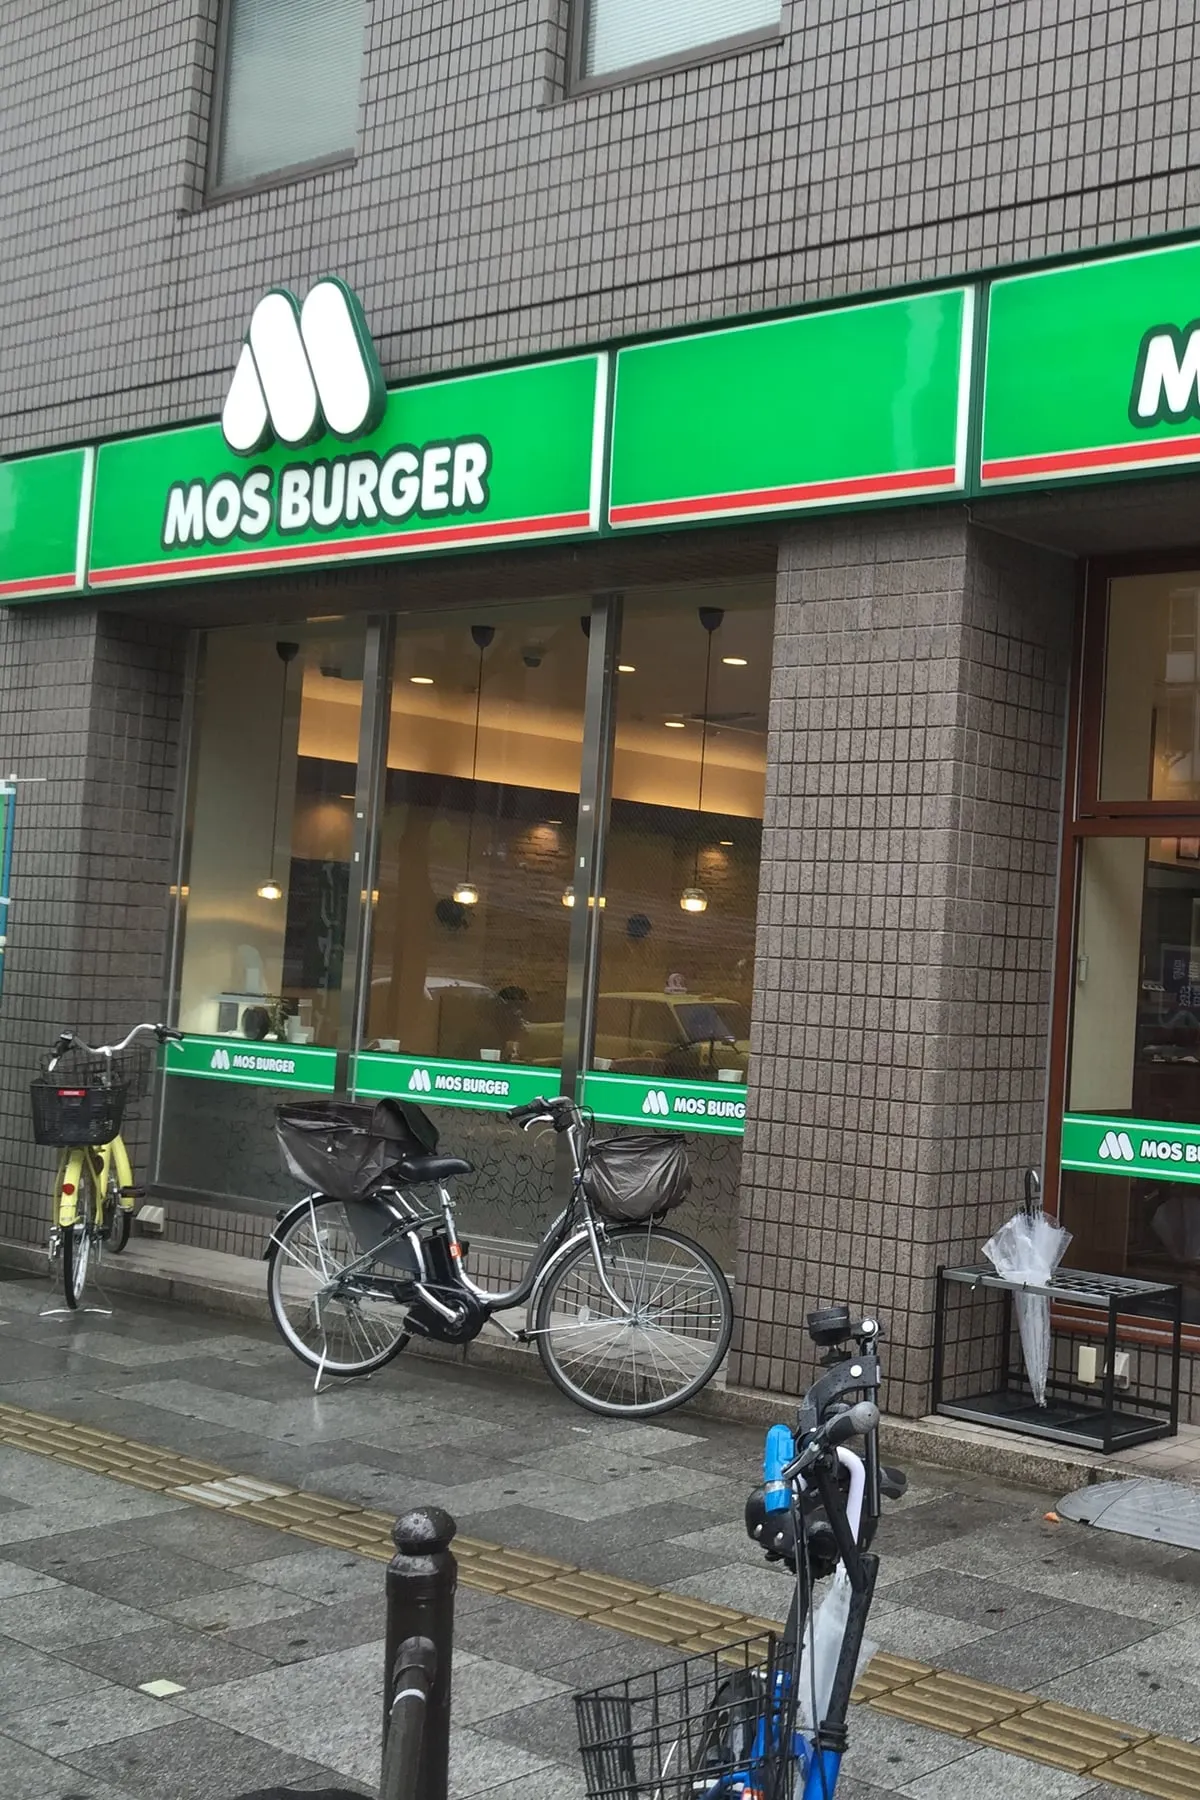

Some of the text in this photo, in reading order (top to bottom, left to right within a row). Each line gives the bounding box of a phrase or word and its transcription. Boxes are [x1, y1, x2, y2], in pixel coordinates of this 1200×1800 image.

[163, 441, 488, 545] MOS BURGER
[232, 1054, 256, 1070] MOS
[256, 1056, 295, 1074] BURGER
[435, 1075, 462, 1091] MOS
[463, 1078, 510, 1096] BURGER
[673, 1097, 706, 1115] MOS
[707, 1100, 746, 1118] BURG
[1140, 1140, 1183, 1161] MOS
